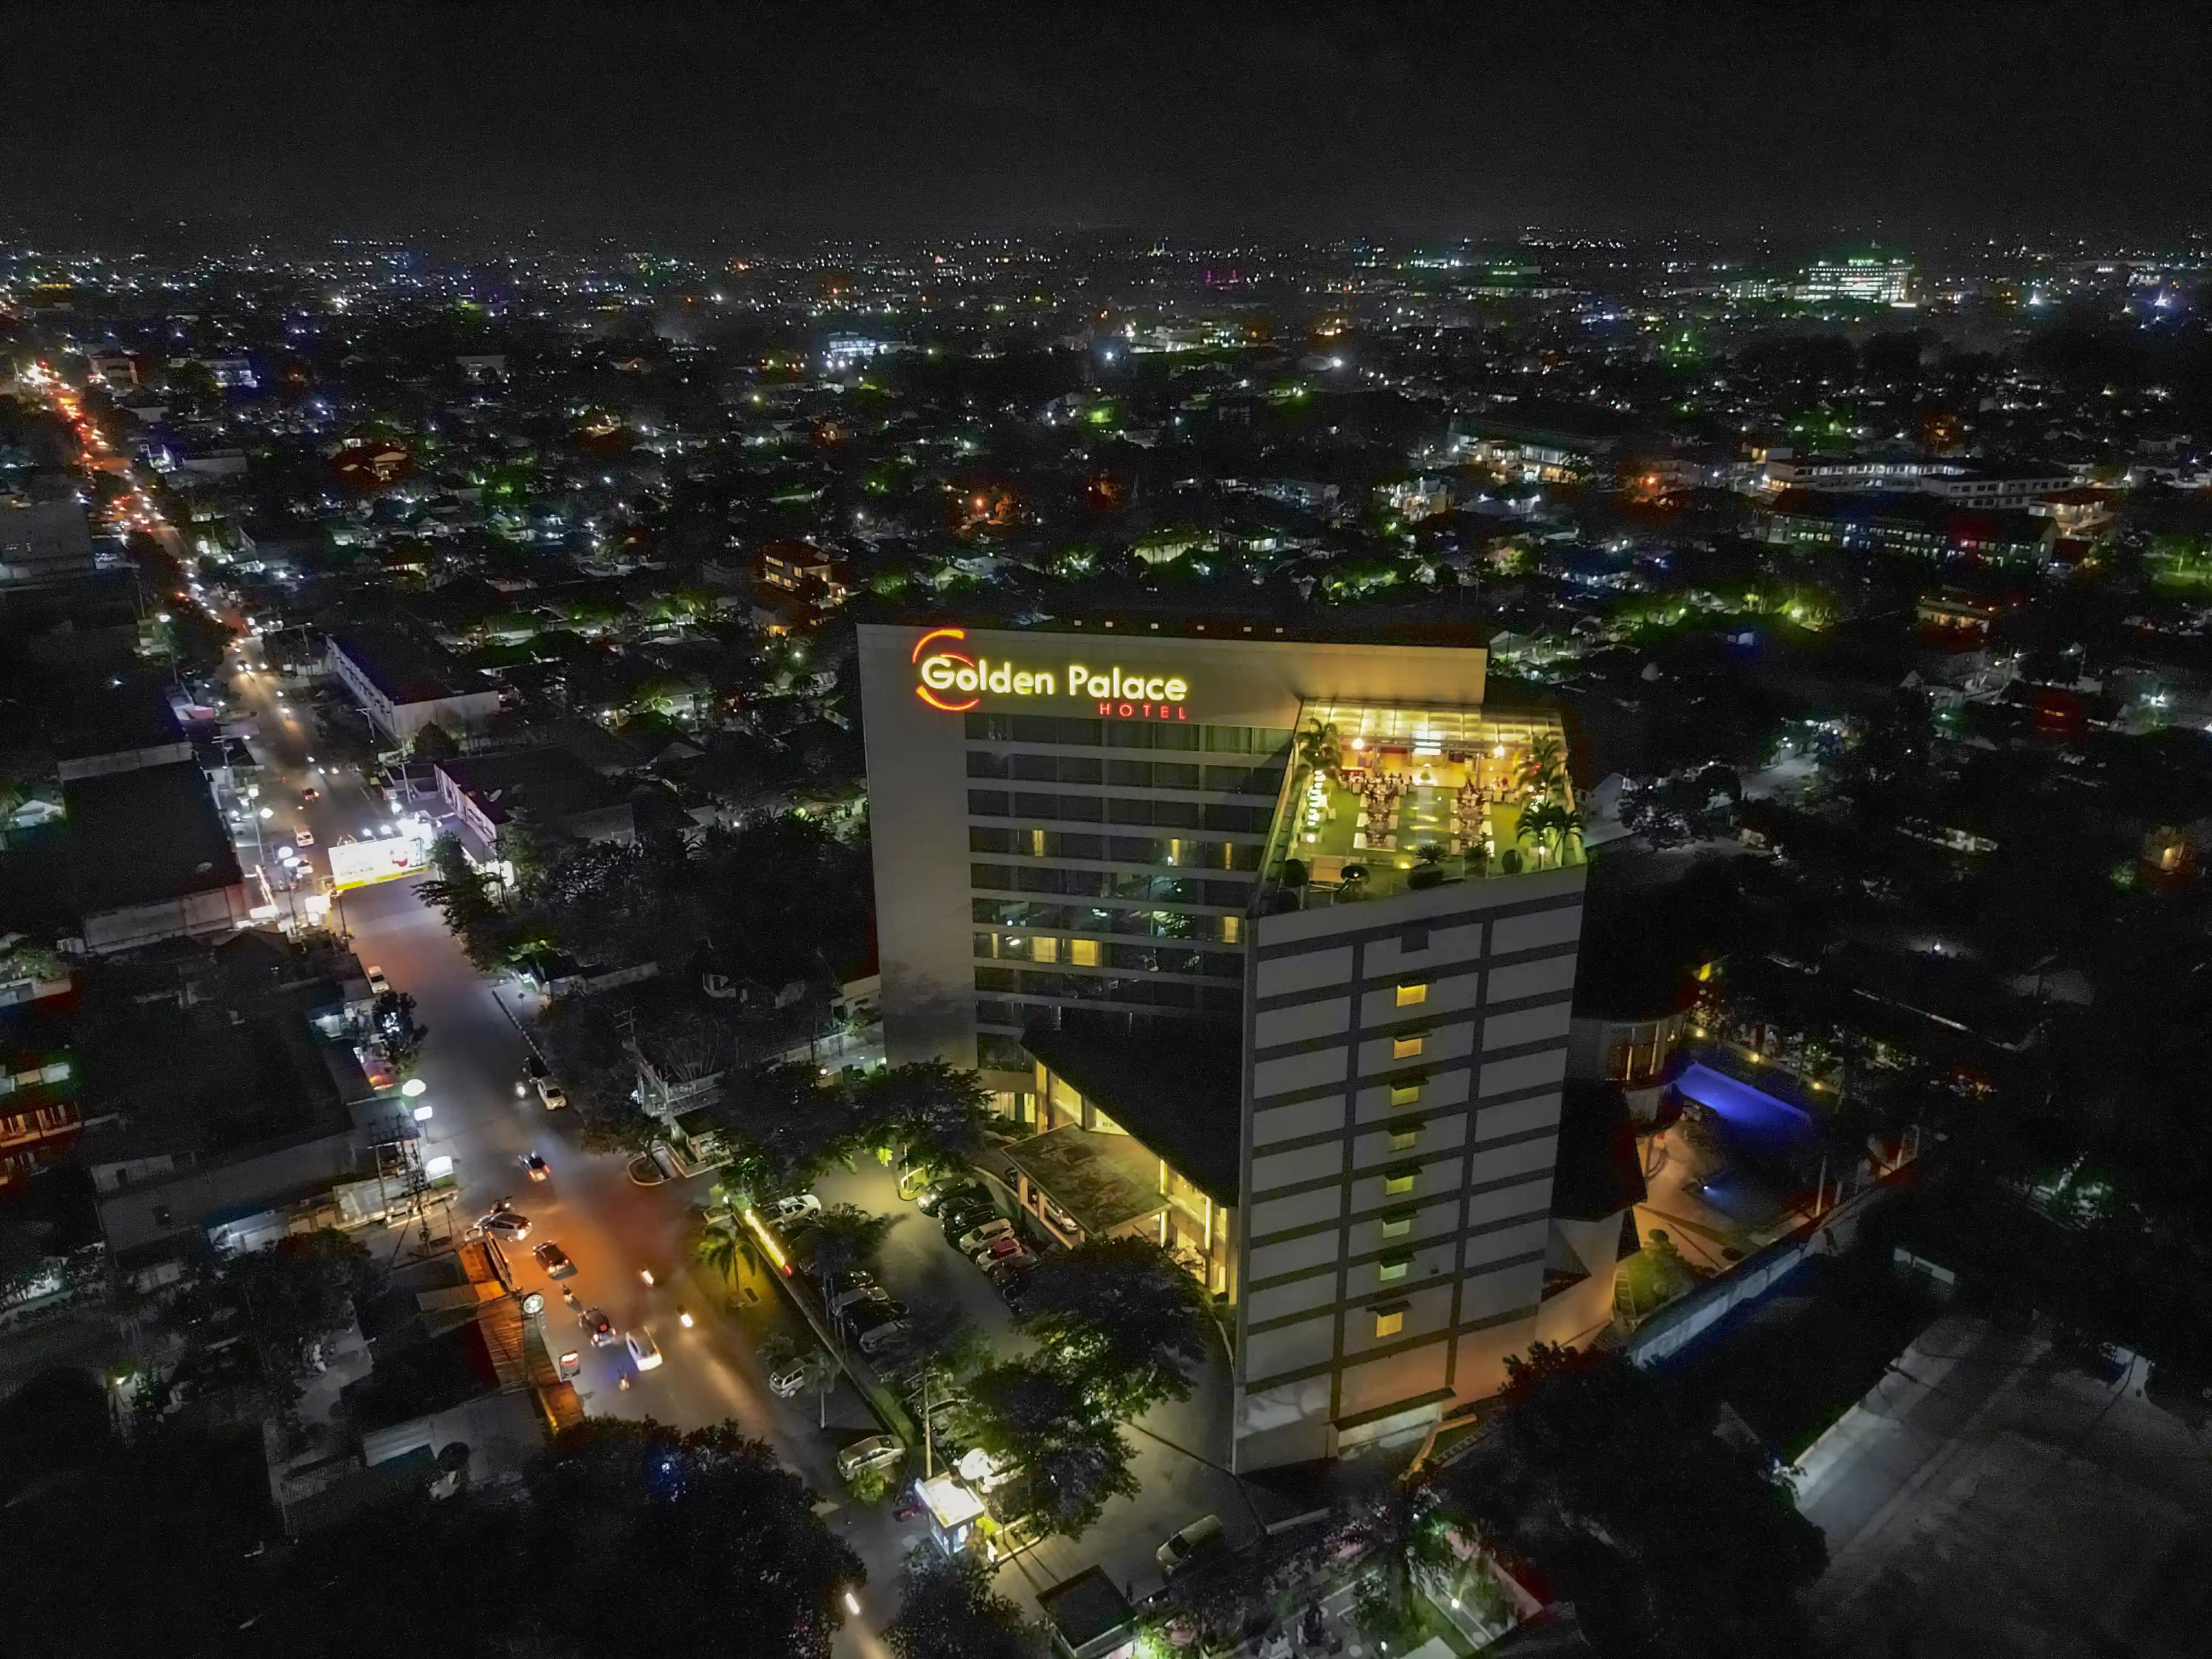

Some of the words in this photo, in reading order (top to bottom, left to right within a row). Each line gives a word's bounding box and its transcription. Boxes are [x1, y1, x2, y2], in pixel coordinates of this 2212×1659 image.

[921, 657, 1054, 695] Golden
[1069, 665, 1187, 701] Palace
[1099, 702, 1187, 720] HOTEL
